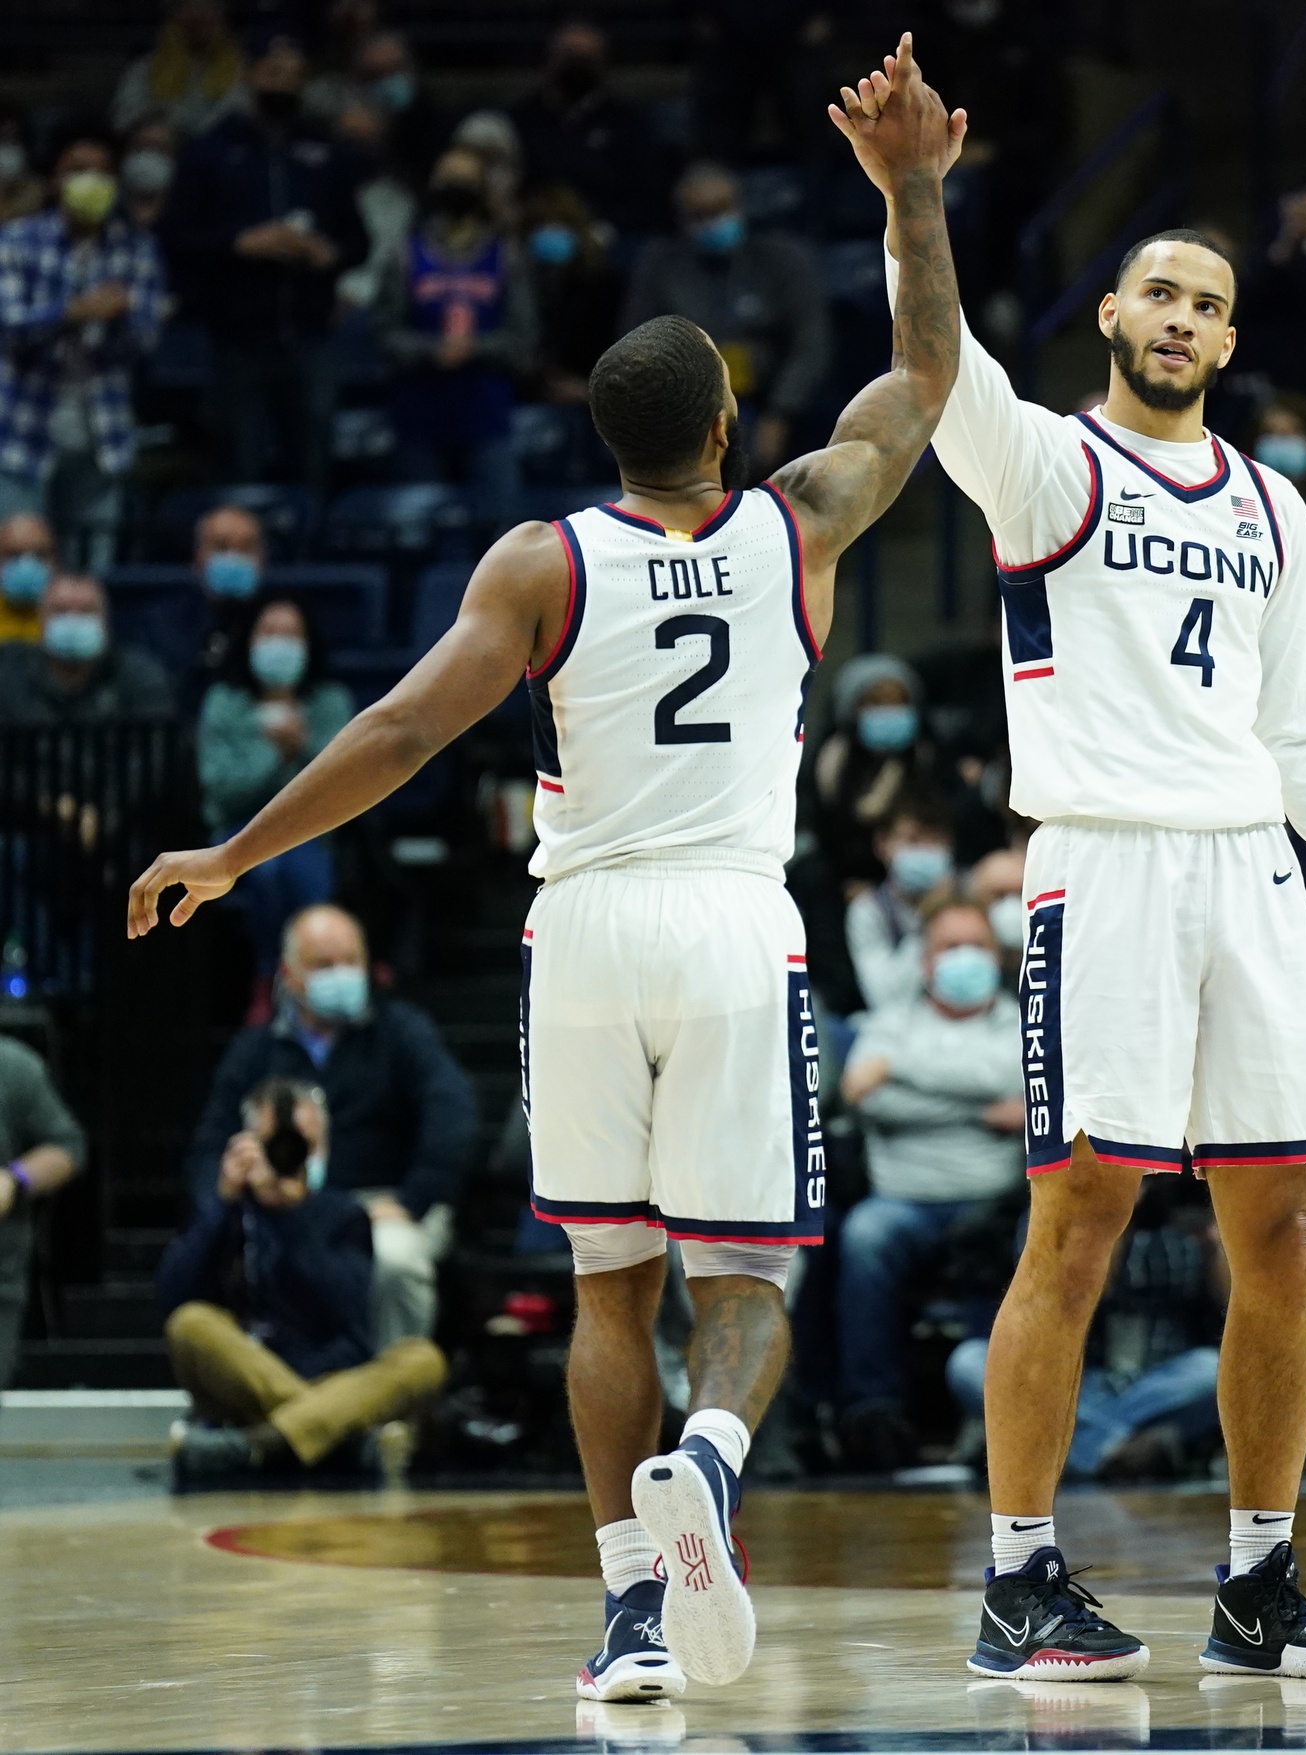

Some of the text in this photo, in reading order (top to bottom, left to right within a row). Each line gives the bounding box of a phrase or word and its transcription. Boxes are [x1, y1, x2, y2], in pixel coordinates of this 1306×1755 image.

[1104, 530, 1274, 599] UCONN
[1236, 529, 1264, 539] EAST
[1238, 521, 1258, 531] BIG
[648, 556, 733, 601] COLE
[654, 614, 731, 745] 2
[1170, 597, 1215, 688] 4
[1025, 924, 1050, 1138] HUSKIES
[799, 988, 827, 1209] HUSKIES
